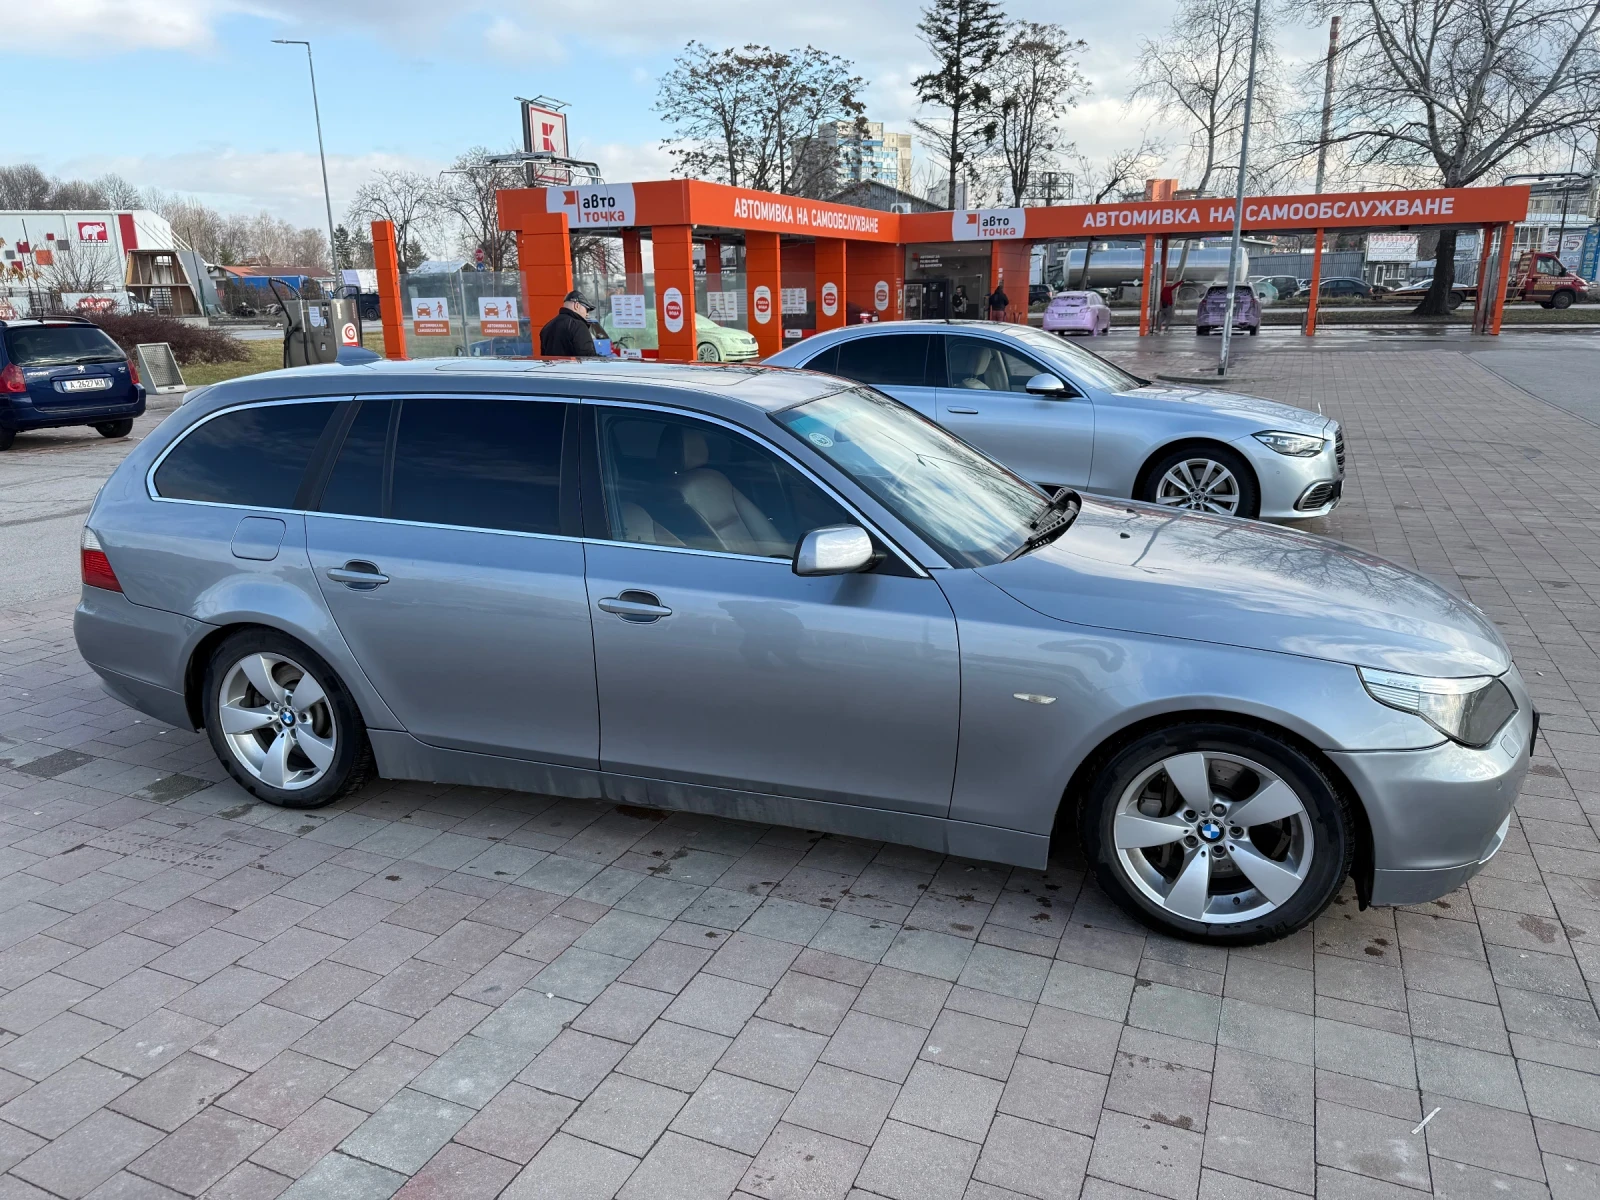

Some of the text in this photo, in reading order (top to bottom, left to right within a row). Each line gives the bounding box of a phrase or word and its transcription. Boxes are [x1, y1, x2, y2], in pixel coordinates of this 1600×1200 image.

[582, 194, 616, 208] авто
[584, 210, 625, 222] точка
[734, 197, 878, 233] АВТОМИВКА НА САМООБСЛУЖВАНЕ
[1082, 197, 1455, 228] АВТОМИВКА НА САМООБСЛУЖВАНЕ
[982, 216, 1010, 226] авто
[982, 227, 1016, 236] точка
